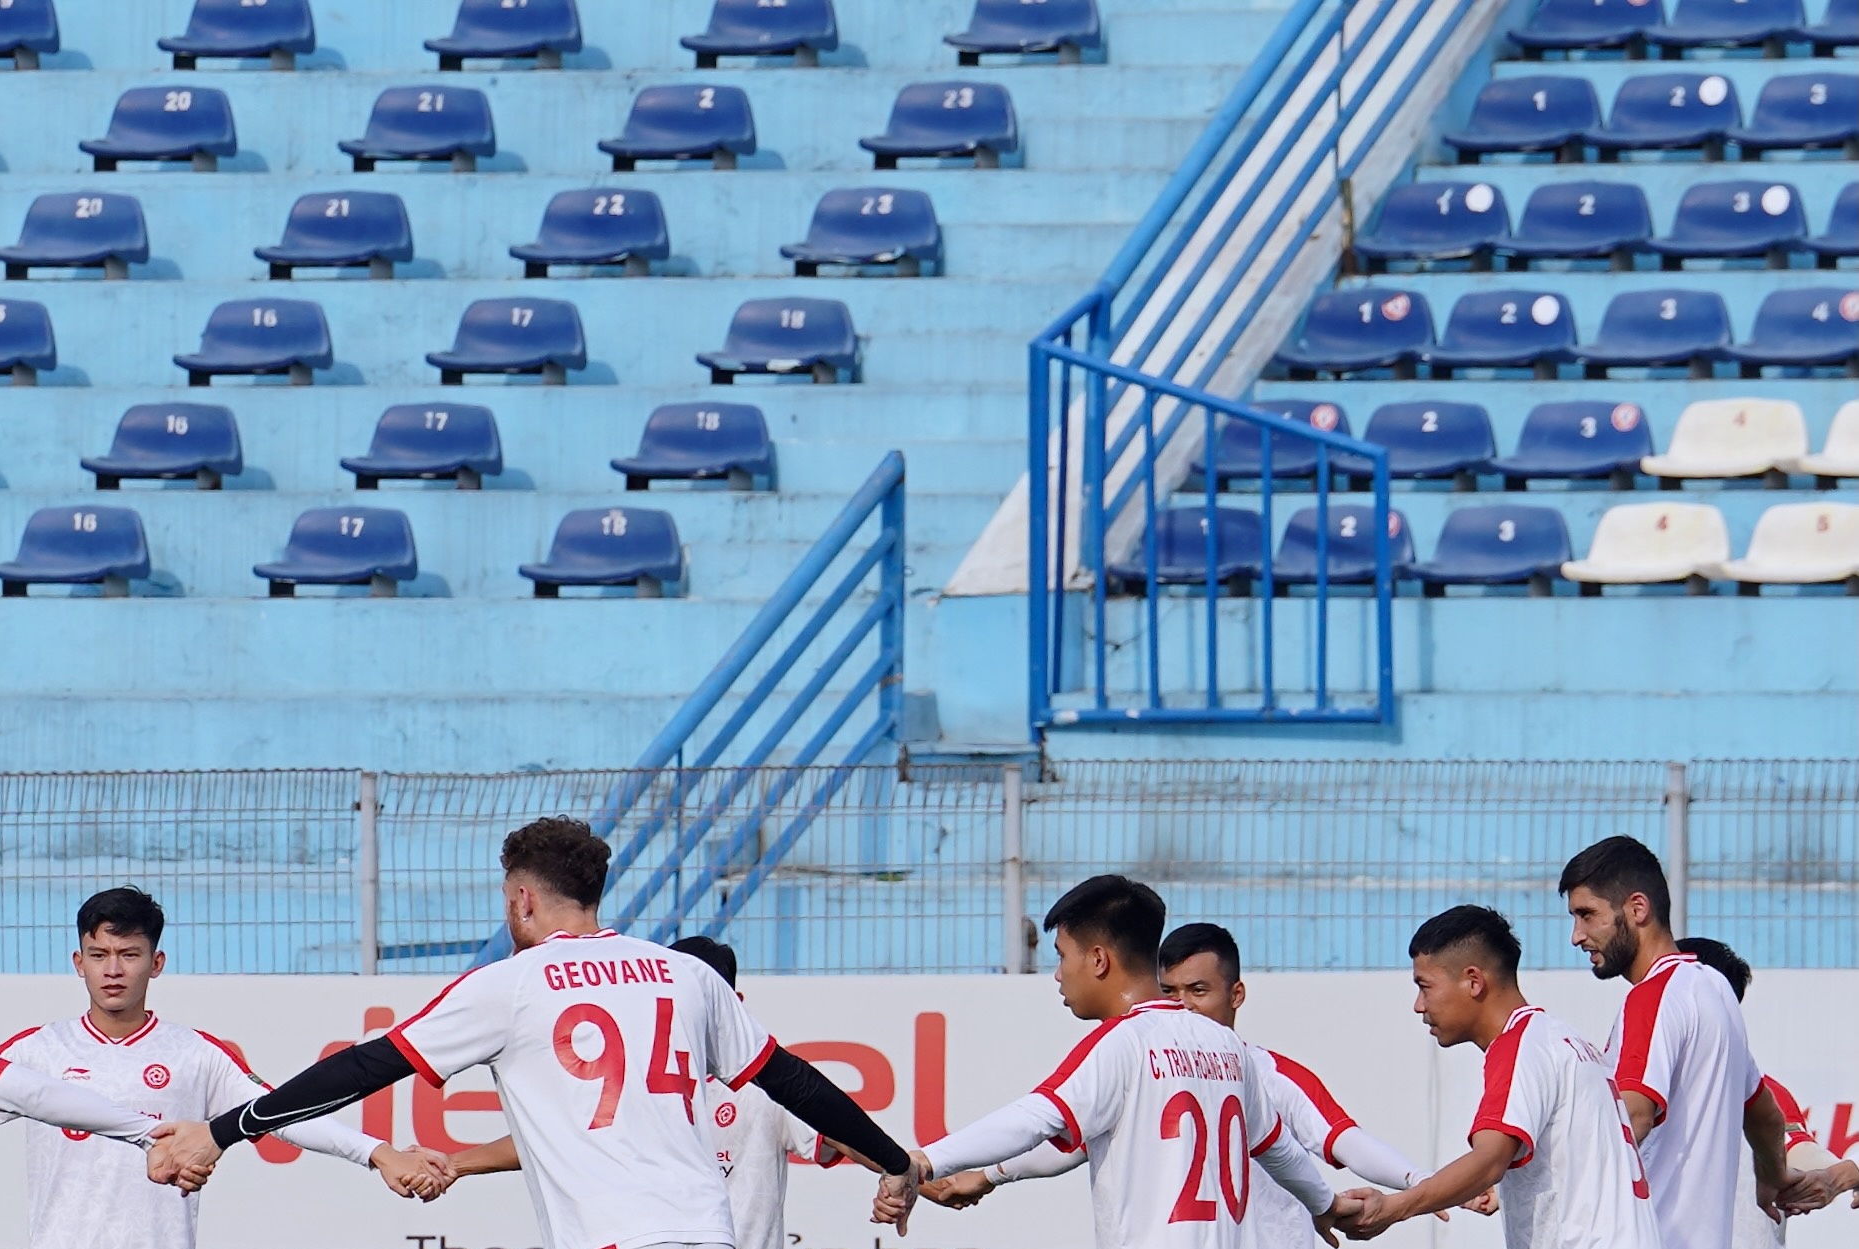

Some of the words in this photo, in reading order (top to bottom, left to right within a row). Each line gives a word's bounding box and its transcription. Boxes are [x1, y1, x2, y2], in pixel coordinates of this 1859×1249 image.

[164, 91, 192, 111] 20
[418, 91, 444, 112] 21
[943, 87, 974, 108] 23
[1533, 90, 1546, 110] 1
[1670, 86, 1686, 106] 2
[1810, 83, 1827, 104] 3
[75, 198, 103, 218] 20
[325, 199, 350, 217] 21
[593, 194, 625, 215] 22
[861, 194, 894, 214] 23
[1579, 194, 1595, 215] 2
[1734, 191, 1750, 212] 3
[252, 308, 277, 326] 16
[511, 307, 534, 326] 17
[780, 309, 806, 328] 18
[1359, 301, 1373, 323] 1
[1501, 302, 1517, 324] 2
[1661, 298, 1677, 320] 3
[1812, 302, 1828, 321] 4
[166, 414, 189, 435] 16
[424, 411, 448, 430] 17
[696, 411, 720, 430] 18
[1422, 410, 1438, 432] 2
[1581, 416, 1597, 438] 3
[73, 512, 97, 532] 16
[340, 516, 365, 537] 17
[602, 512, 627, 532] 18
[1340, 515, 1357, 537] 2
[1499, 520, 1515, 541] 3
[544, 959, 674, 990] GEOVANE
[553, 997, 698, 1130] 94
[1160, 1090, 1250, 1225] 20
